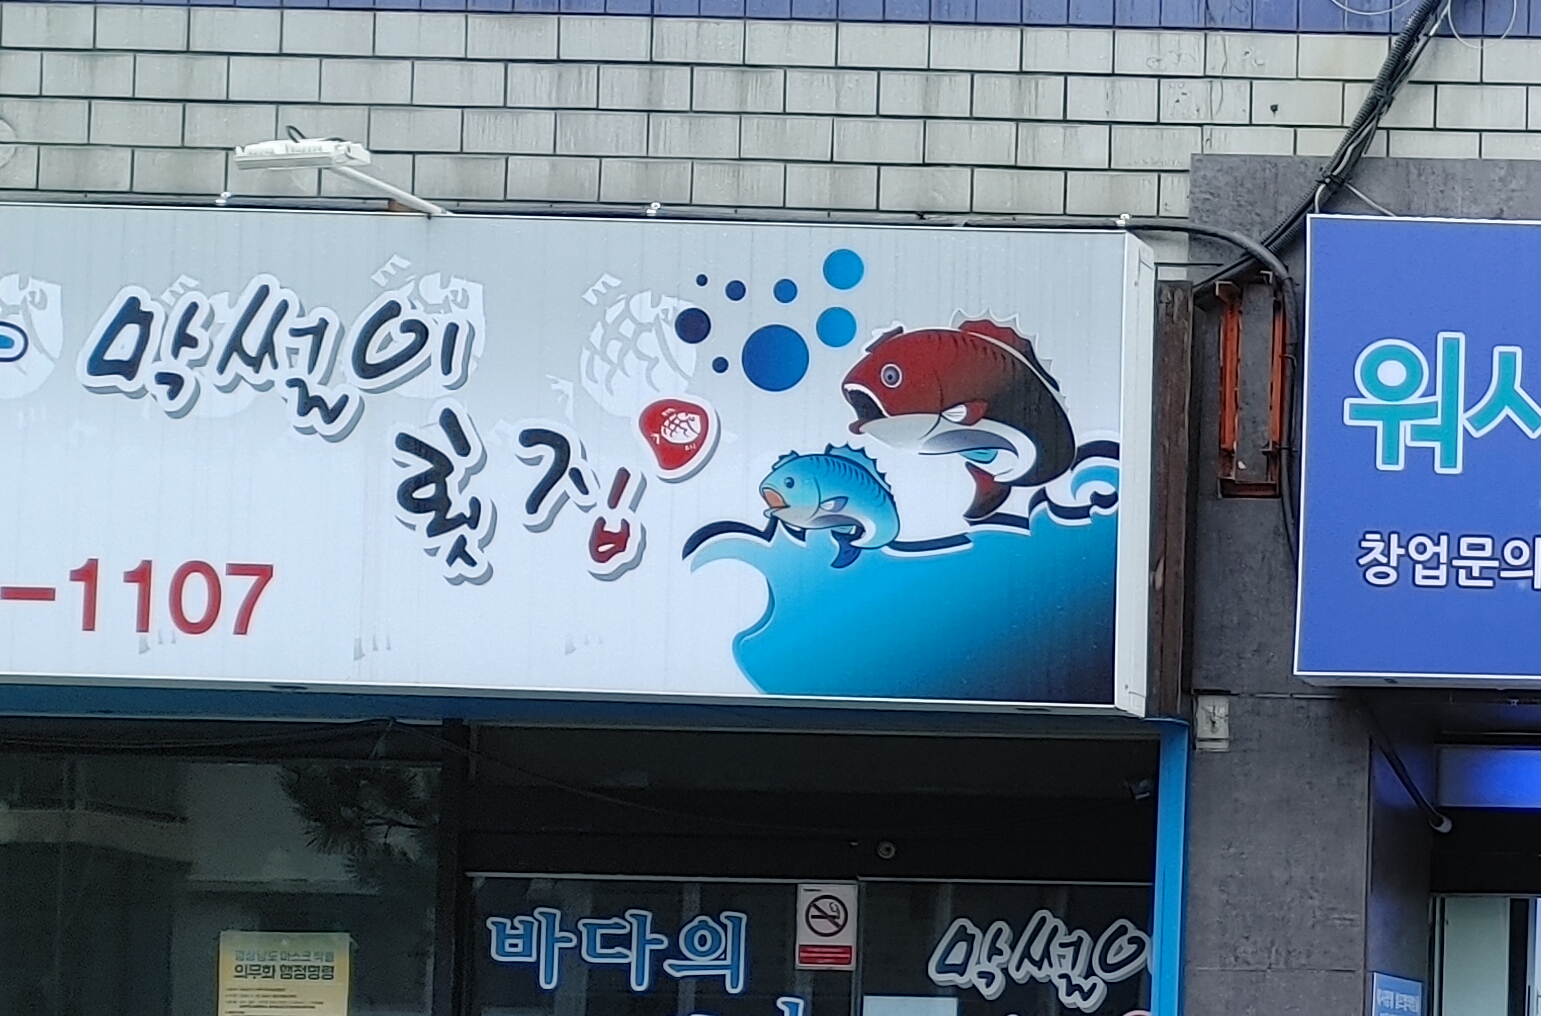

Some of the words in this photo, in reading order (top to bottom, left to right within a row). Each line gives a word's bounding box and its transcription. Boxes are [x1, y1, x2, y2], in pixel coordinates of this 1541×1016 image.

[82, 275, 478, 434] 막썰이
[233, 964, 277, 980] 의무화
[279, 964, 336, 981] 행정명령
[487, 906, 748, 994] 바다의
